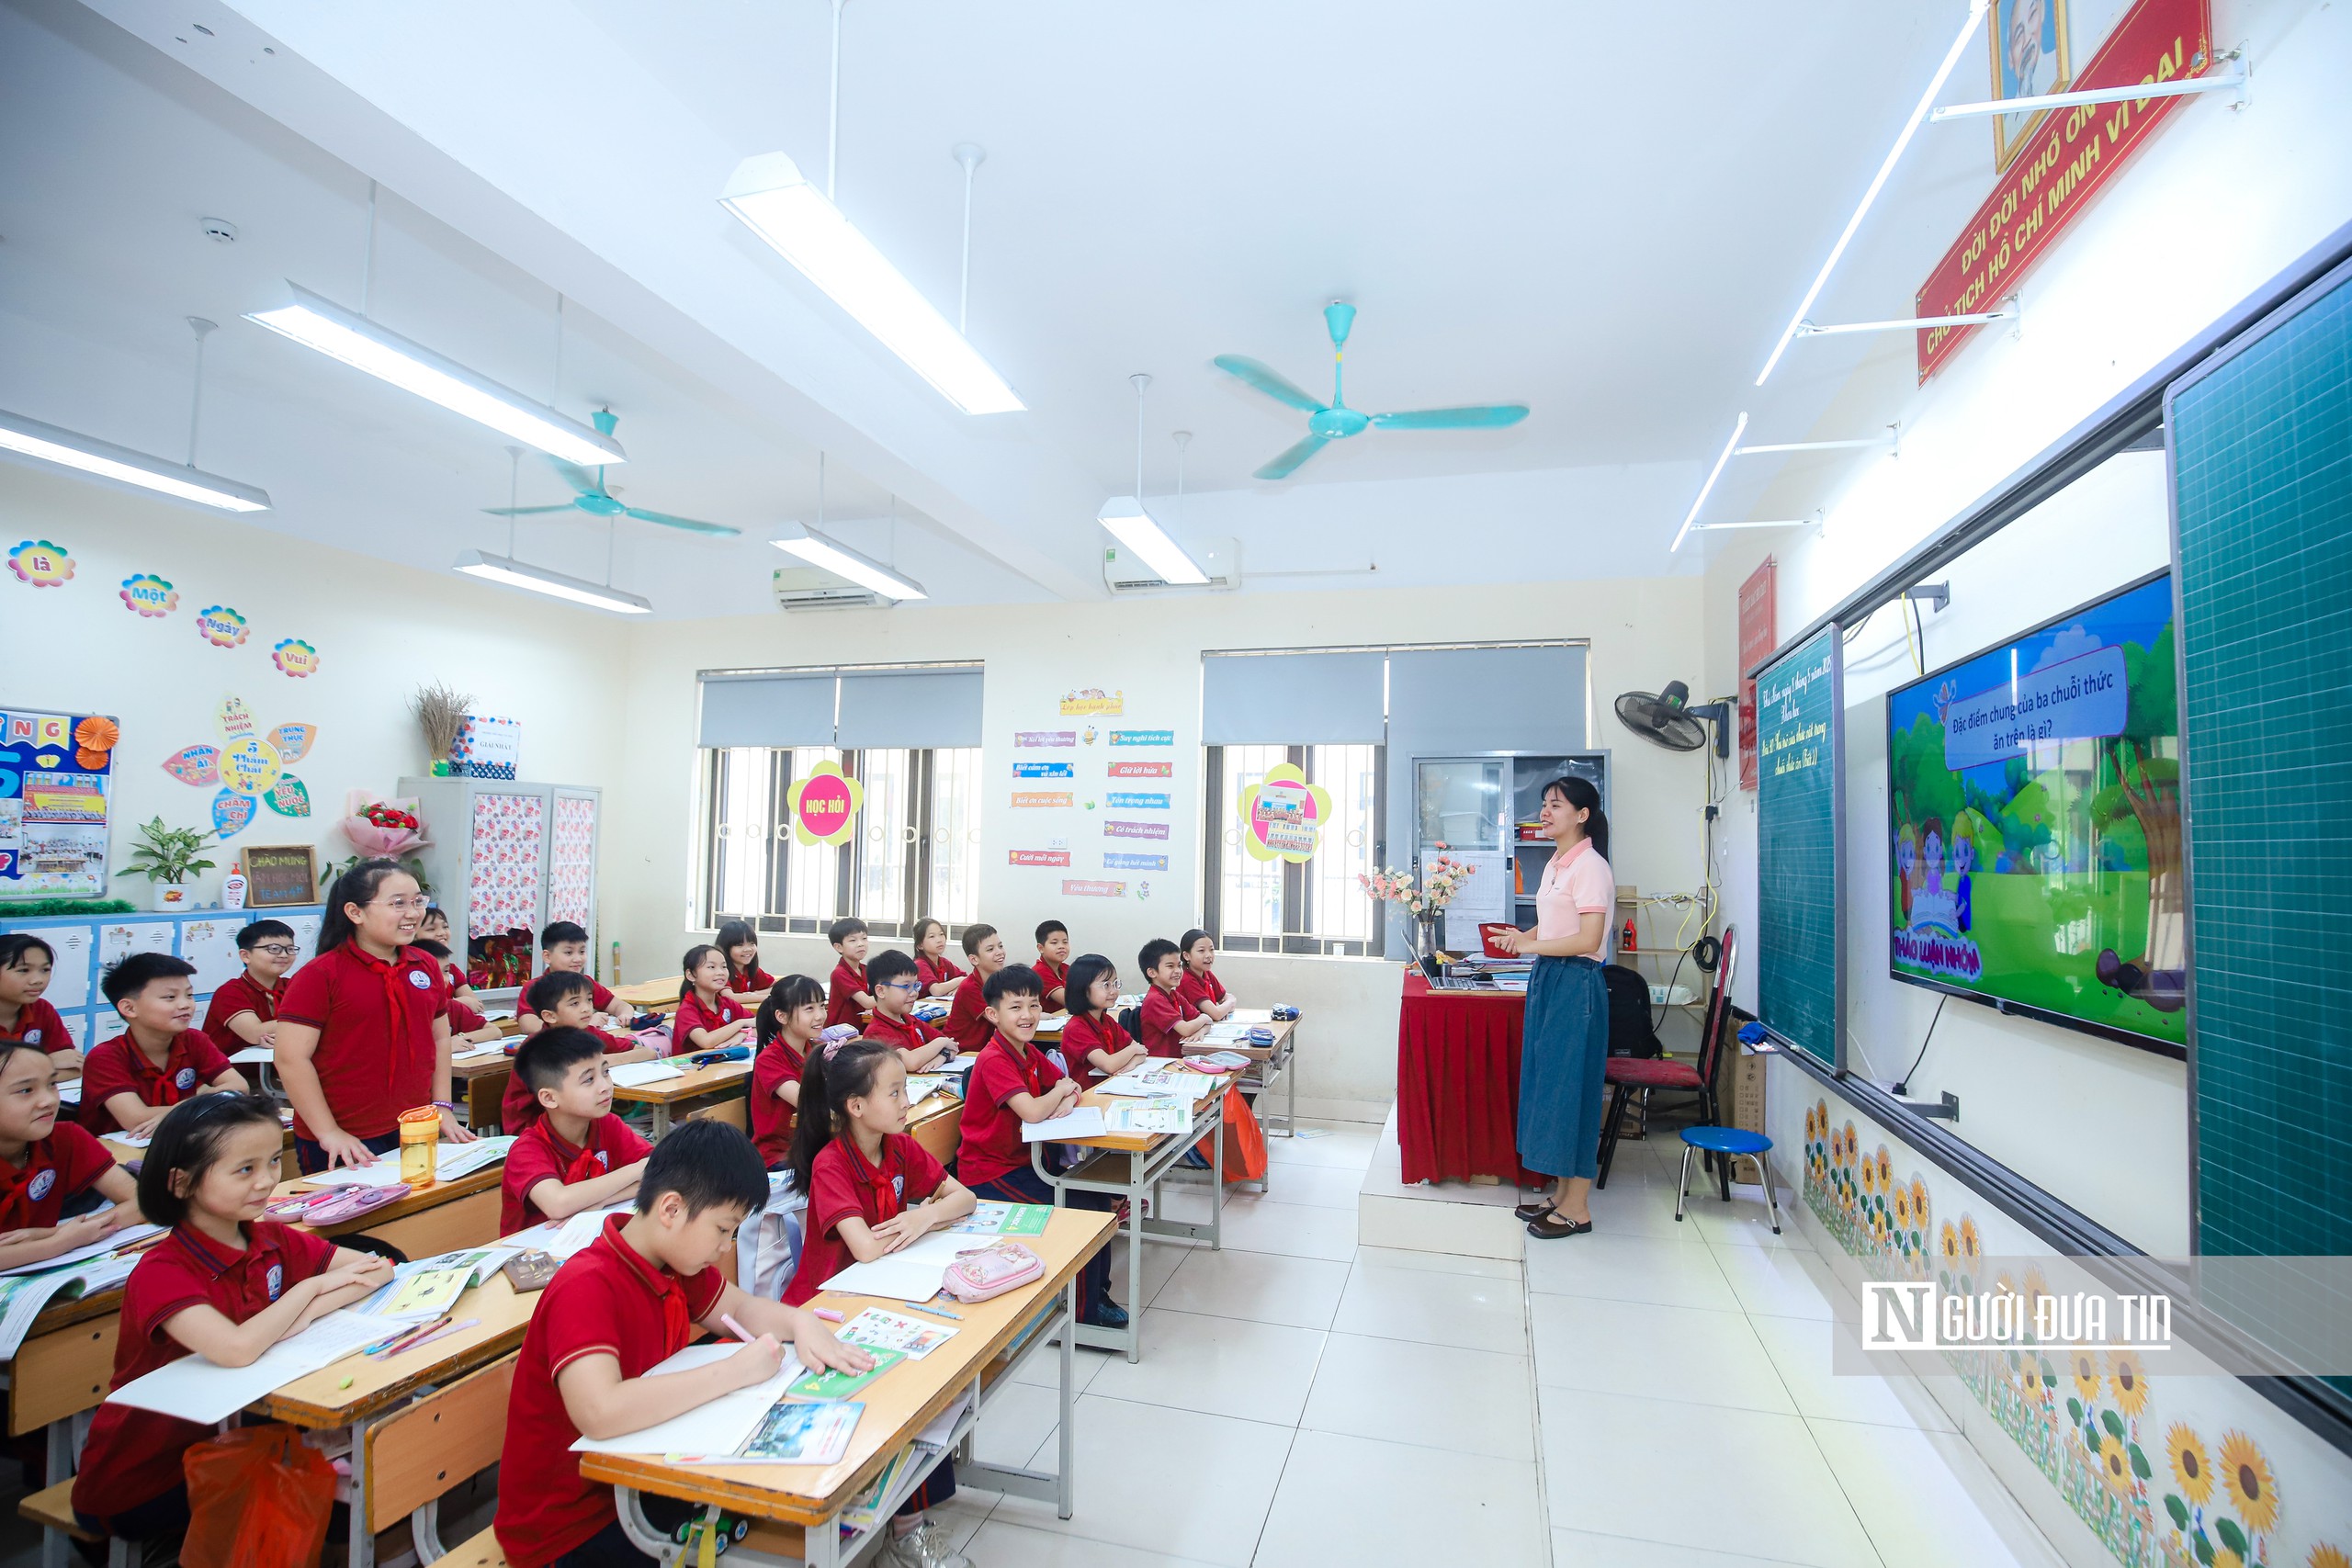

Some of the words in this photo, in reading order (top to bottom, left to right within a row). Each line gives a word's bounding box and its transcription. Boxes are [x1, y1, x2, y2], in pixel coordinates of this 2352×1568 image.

[1962, 227, 1986, 276] ĐỜI
[1989, 187, 2018, 241] ĐỜI
[2021, 130, 2061, 201] NHỚ
[1988, 231, 2011, 284] HỒ
[2014, 192, 2043, 252] CHÍ
[2048, 133, 2101, 216] MINH
[33, 556, 51, 571] là
[131, 587, 167, 604] Một
[206, 617, 241, 637] Ngày
[285, 651, 308, 665] Vui
[1952, 716, 1967, 736] Đặc
[1968, 708, 1988, 729] điểm
[1989, 704, 2017, 724] chung
[2017, 694, 2034, 715] của
[2036, 691, 2049, 709] ba
[2052, 675, 2081, 705] chuỗi
[2084, 670, 2113, 695] thức
[223, 711, 250, 722] TRÁCH
[225, 721, 253, 733] NHIỆM
[278, 726, 306, 735] TRUNG
[1994, 733, 2005, 750] ăn
[2006, 728, 2025, 747] trên
[2027, 721, 2036, 741] là
[2038, 718, 2052, 743] gì?
[1120, 734, 1132, 742] Suy
[183, 745, 214, 761] NHÂN
[217, 796, 251, 809] CHĂM
[806, 799, 826, 817] HỌC
[827, 795, 845, 814] HỎI
[1144, 796, 1163, 805] nhau
[1918, 938, 1944, 969] LUẬN
[1944, 943, 1980, 976] NHÓM
